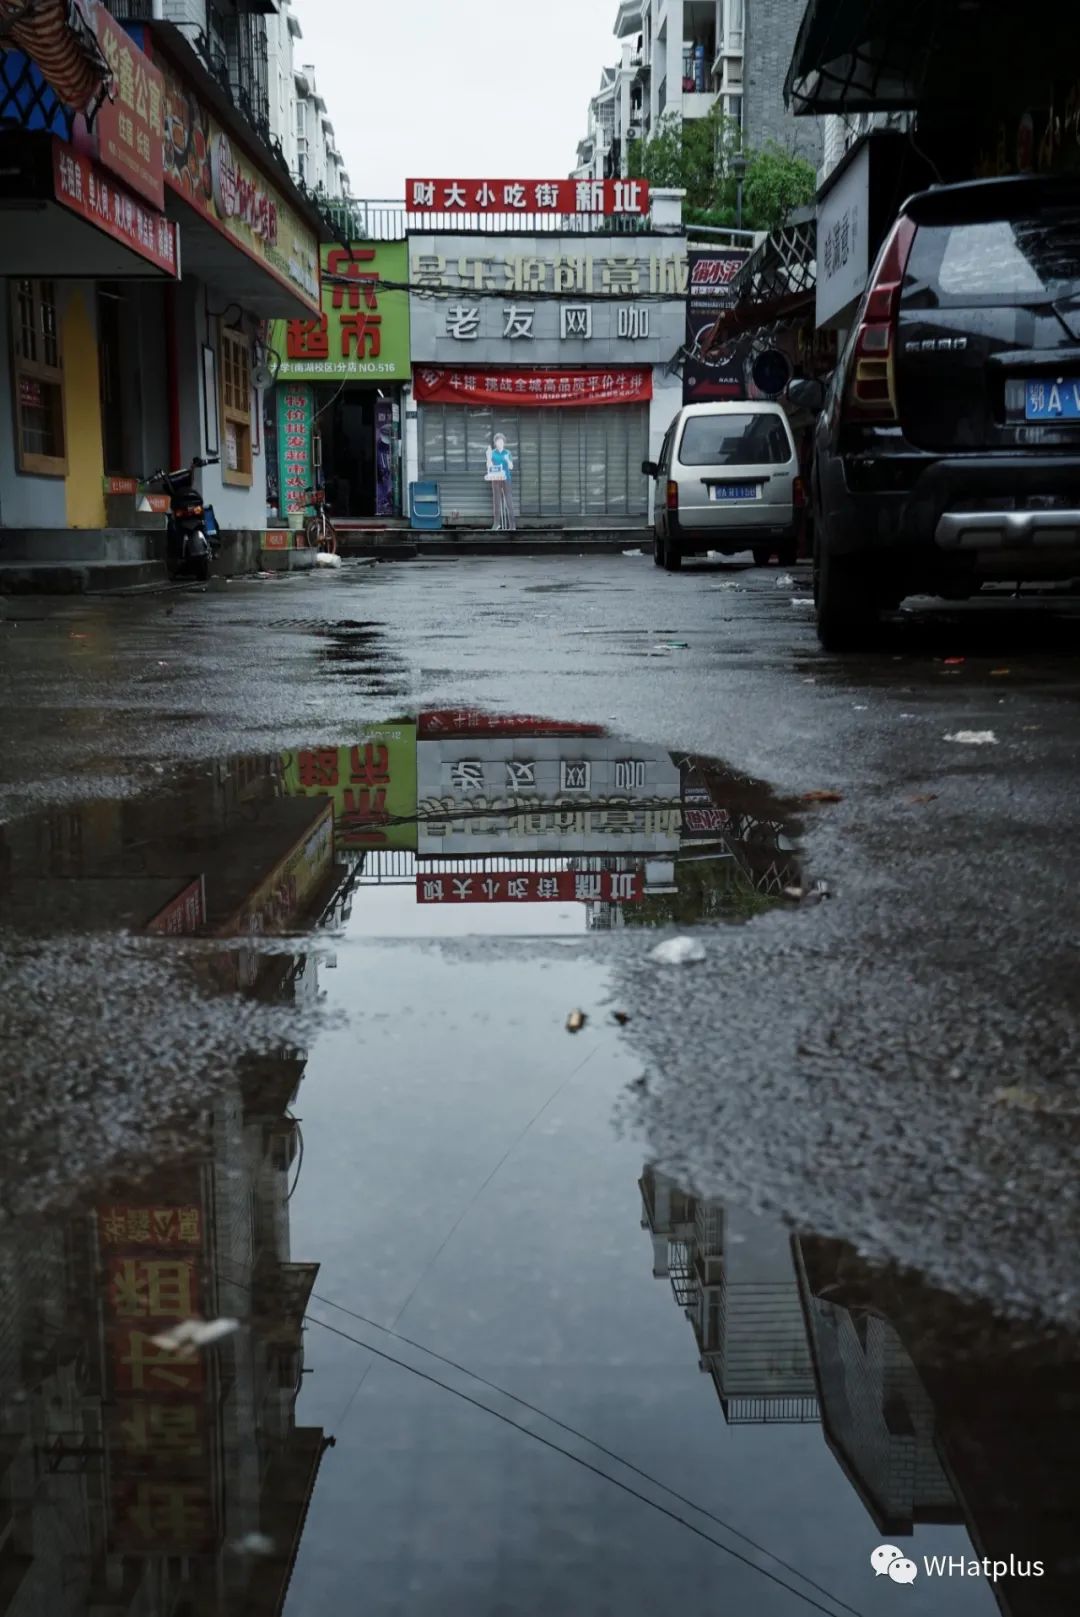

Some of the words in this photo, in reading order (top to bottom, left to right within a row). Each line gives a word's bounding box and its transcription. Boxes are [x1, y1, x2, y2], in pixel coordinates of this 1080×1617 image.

[413, 181, 559, 208] 财大小吃街
[575, 181, 642, 212] 新址
[287, 312, 382, 359] 超市
[446, 305, 649, 339] 老友网咖
[360, 363, 396, 373] NO.516
[449, 374, 477, 391] 牛排
[484, 374, 643, 392] 挑战全城高品质平价牛排
